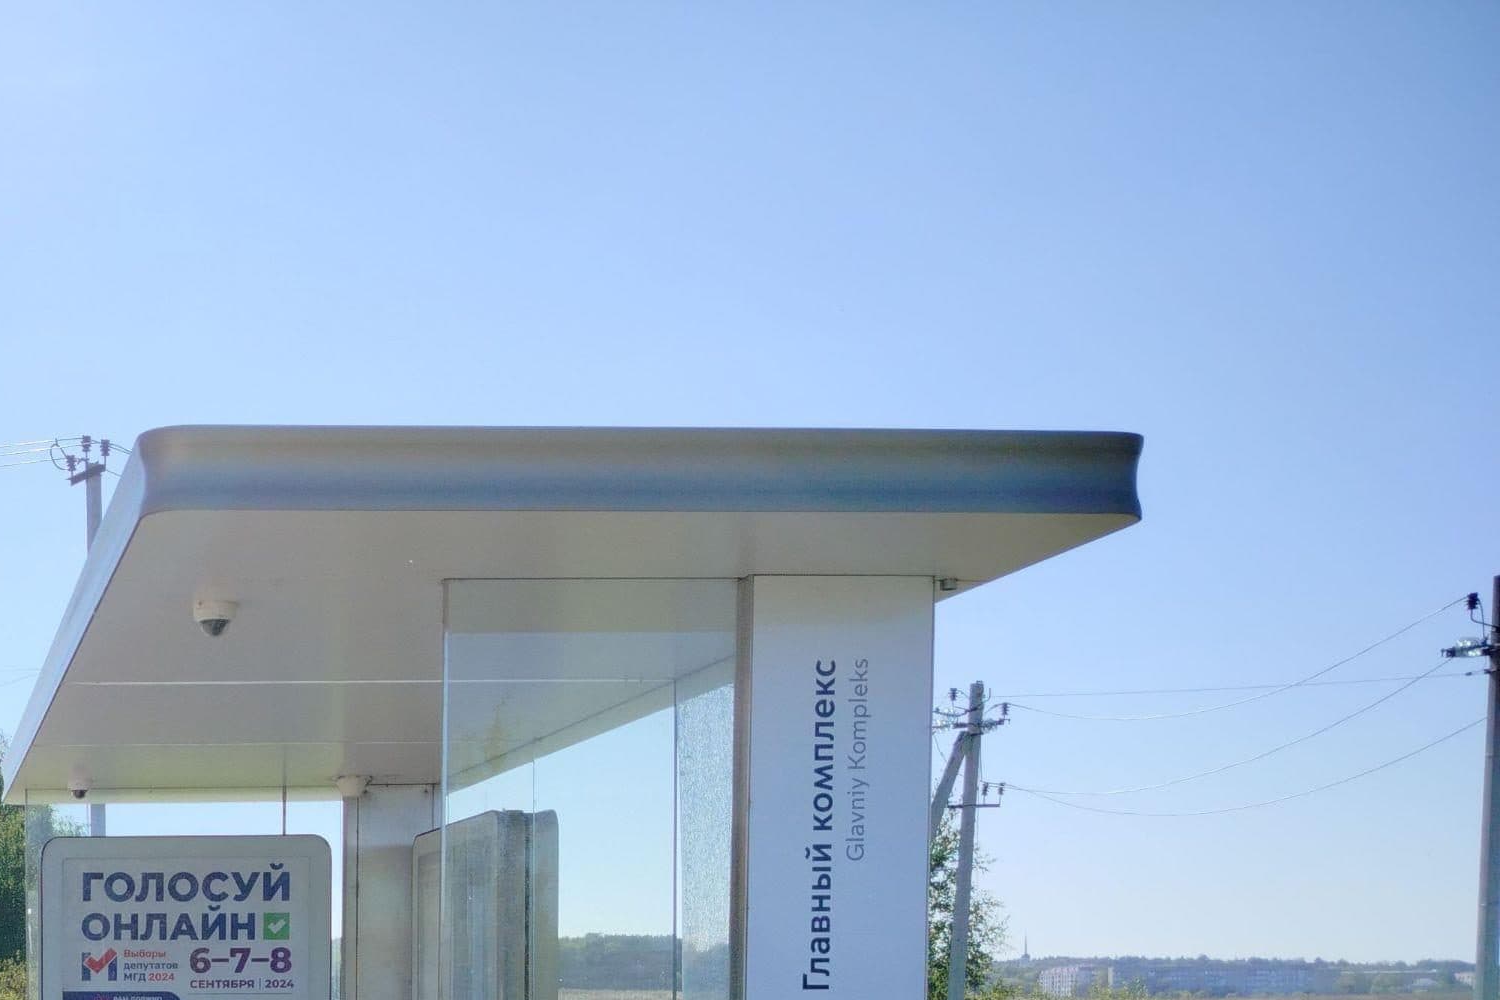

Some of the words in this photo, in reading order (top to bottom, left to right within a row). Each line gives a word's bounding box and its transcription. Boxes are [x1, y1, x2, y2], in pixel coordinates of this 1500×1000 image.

[847, 658, 873, 770] Kompleks
[812, 659, 836, 831] комплекс
[845, 777, 870, 861] Glavniy
[82, 863, 290, 901] ГОЛОСУЙ
[81, 905, 256, 941] ОНЛАЙН
[802, 843, 832, 990] Главный
[123, 949, 166, 960] Выборы
[123, 961, 178, 971] депутатов
[123, 973, 147, 983] МГД
[148, 972, 175, 982] 2024
[190, 979, 255, 989] СЕНТЯБРЯ
[265, 979, 294, 989] 2024
